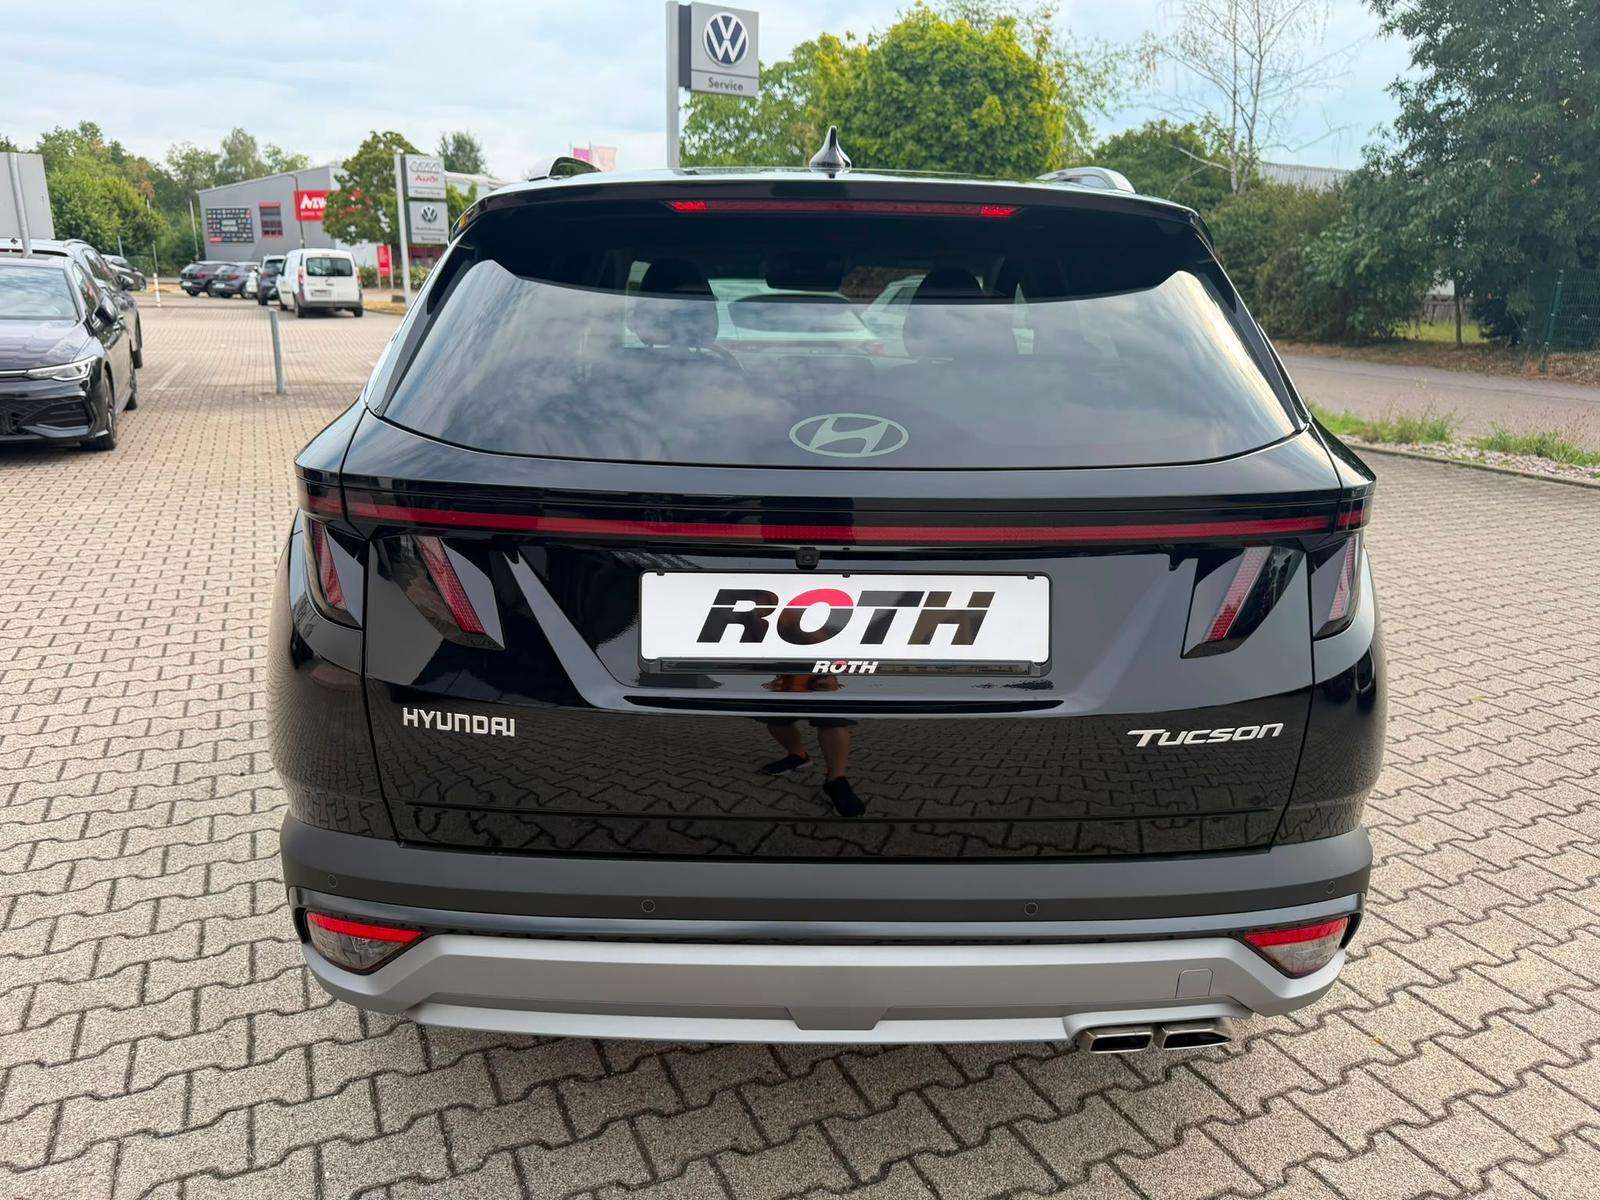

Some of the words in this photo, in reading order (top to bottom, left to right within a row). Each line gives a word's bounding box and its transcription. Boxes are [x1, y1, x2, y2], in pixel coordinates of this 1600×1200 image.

[708, 77, 744, 91] Service
[415, 175, 439, 184] Audi
[696, 588, 996, 646] ROTH
[811, 659, 879, 674] ROTH
[402, 707, 515, 737] HYUNDAI
